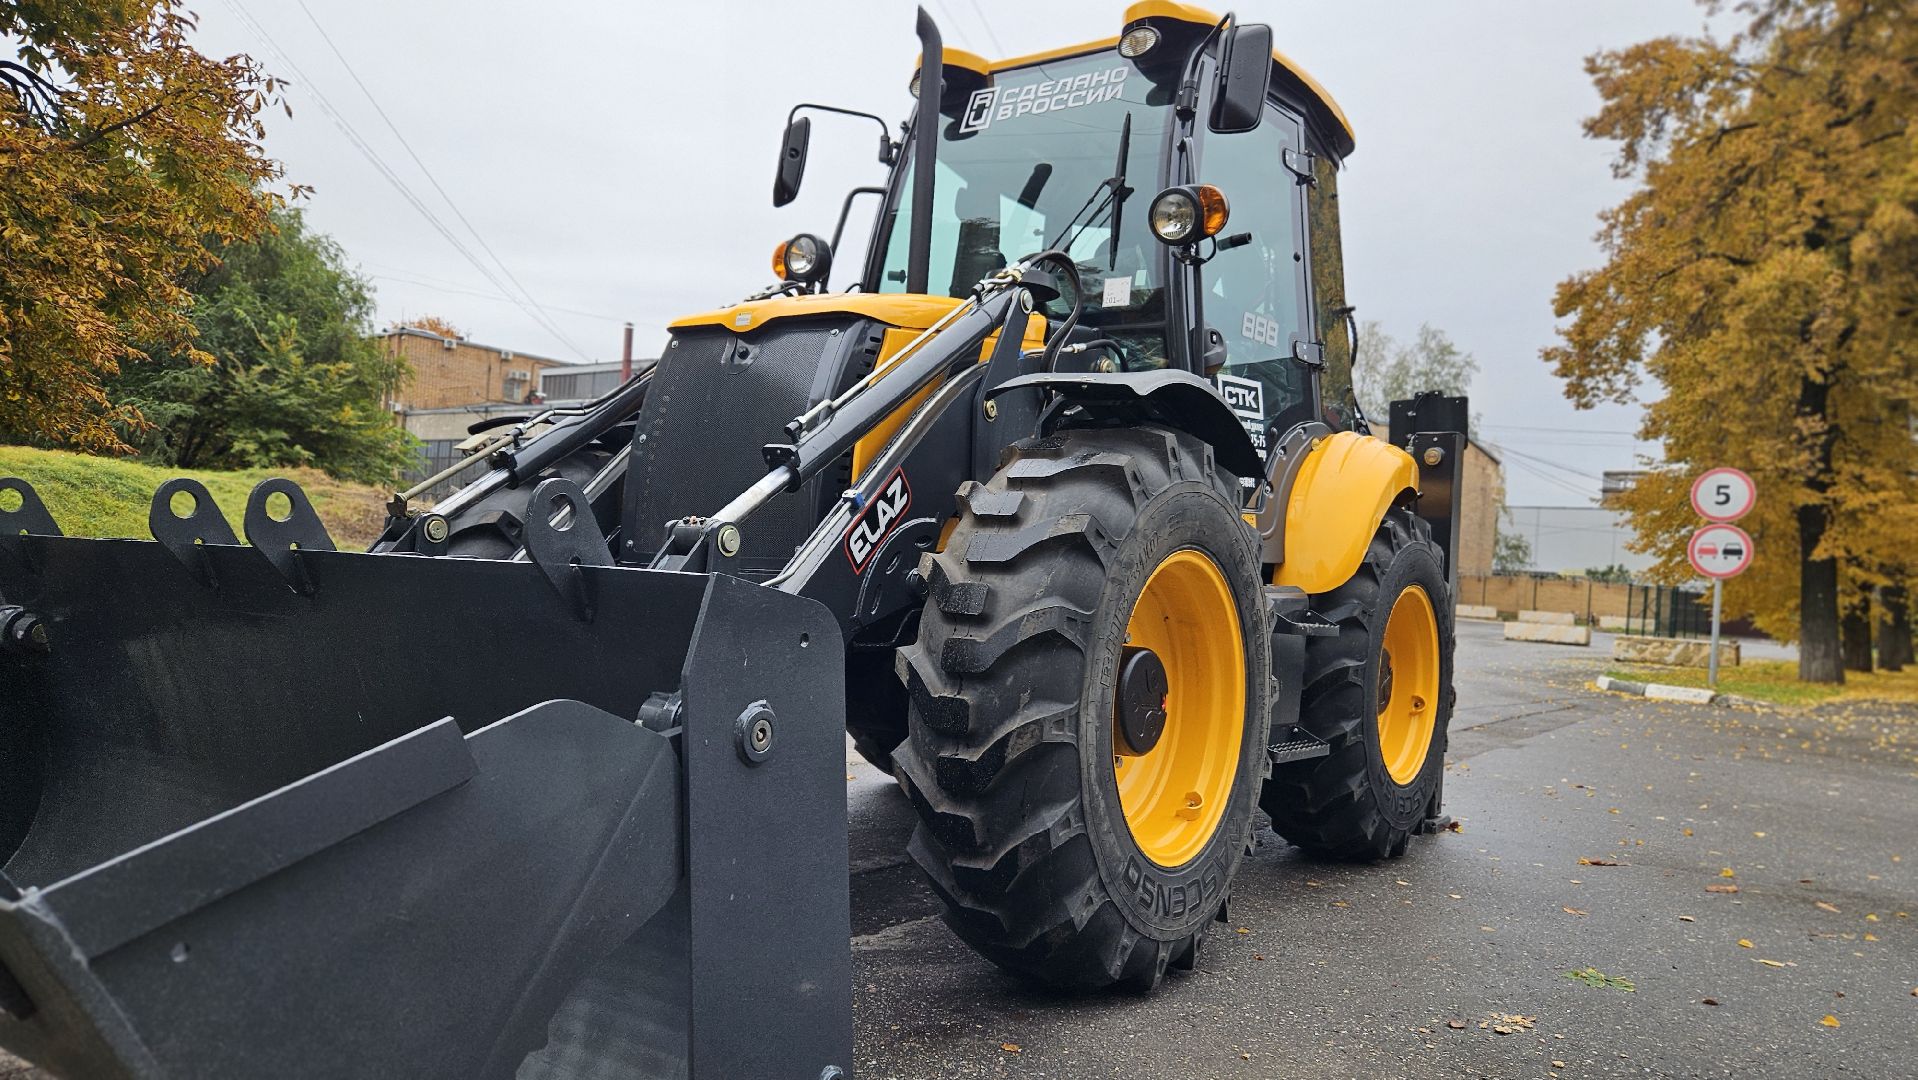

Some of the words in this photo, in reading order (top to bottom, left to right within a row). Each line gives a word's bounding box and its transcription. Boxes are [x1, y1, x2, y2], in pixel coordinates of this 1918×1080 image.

[997, 103, 1014, 121] В
[1016, 82, 1125, 118] РОССИИ
[1001, 66, 1129, 104] СДЕЛАНО
[1714, 484, 1731, 506] 5
[849, 475, 908, 564] ELAZ
[1121, 838, 1231, 920] ASCENSO
